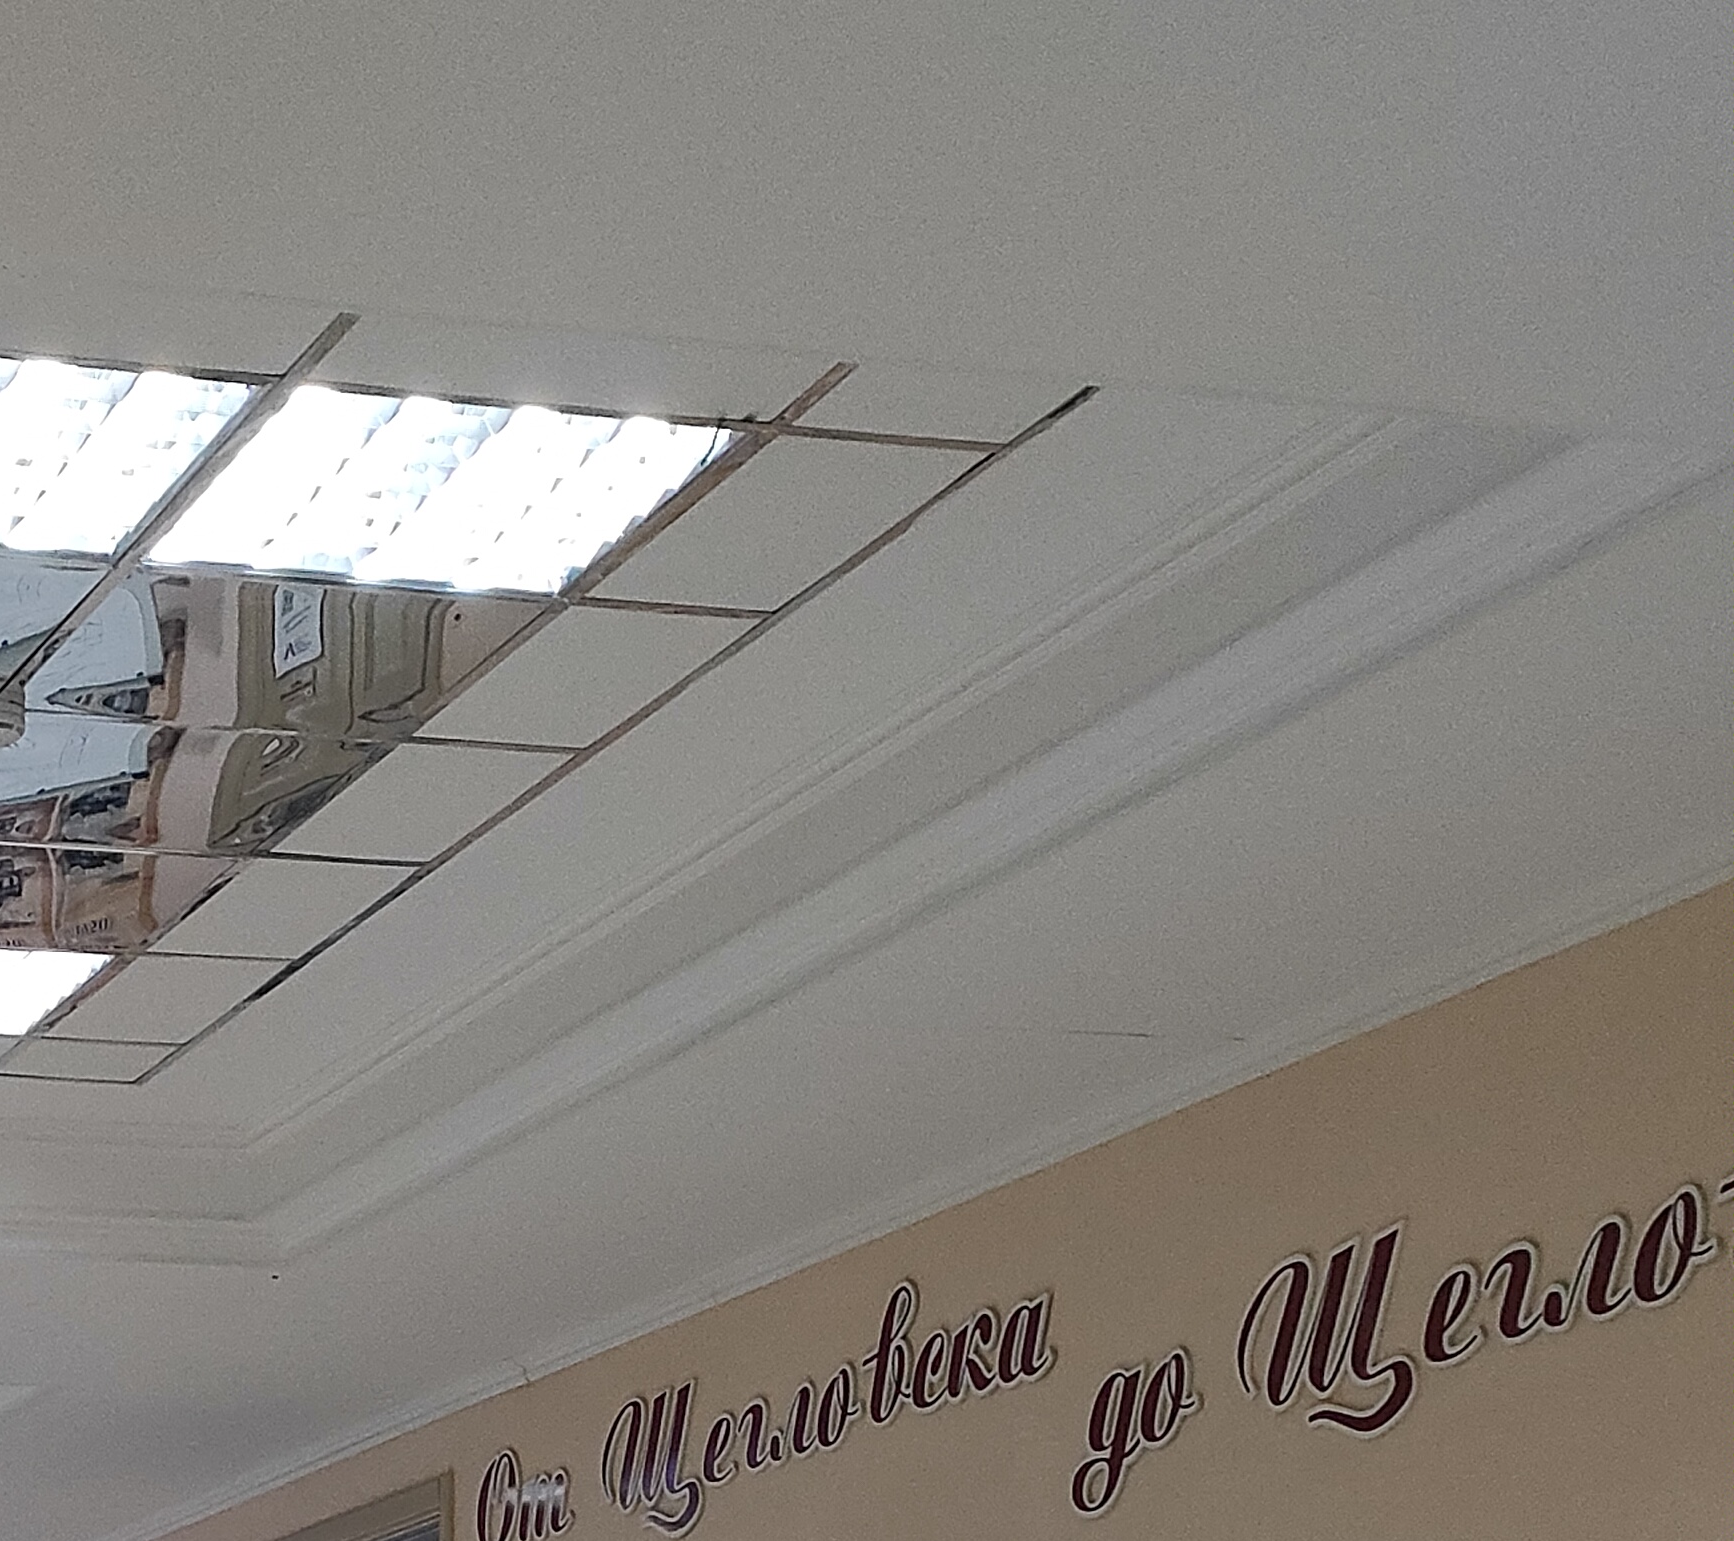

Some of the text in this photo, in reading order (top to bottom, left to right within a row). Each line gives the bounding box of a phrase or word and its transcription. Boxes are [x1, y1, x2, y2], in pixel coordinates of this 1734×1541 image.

[602, 1281, 1053, 1536] Щегловска
[1072, 1347, 1196, 1515] до
[1238, 1183, 1734, 1432] Щегло
